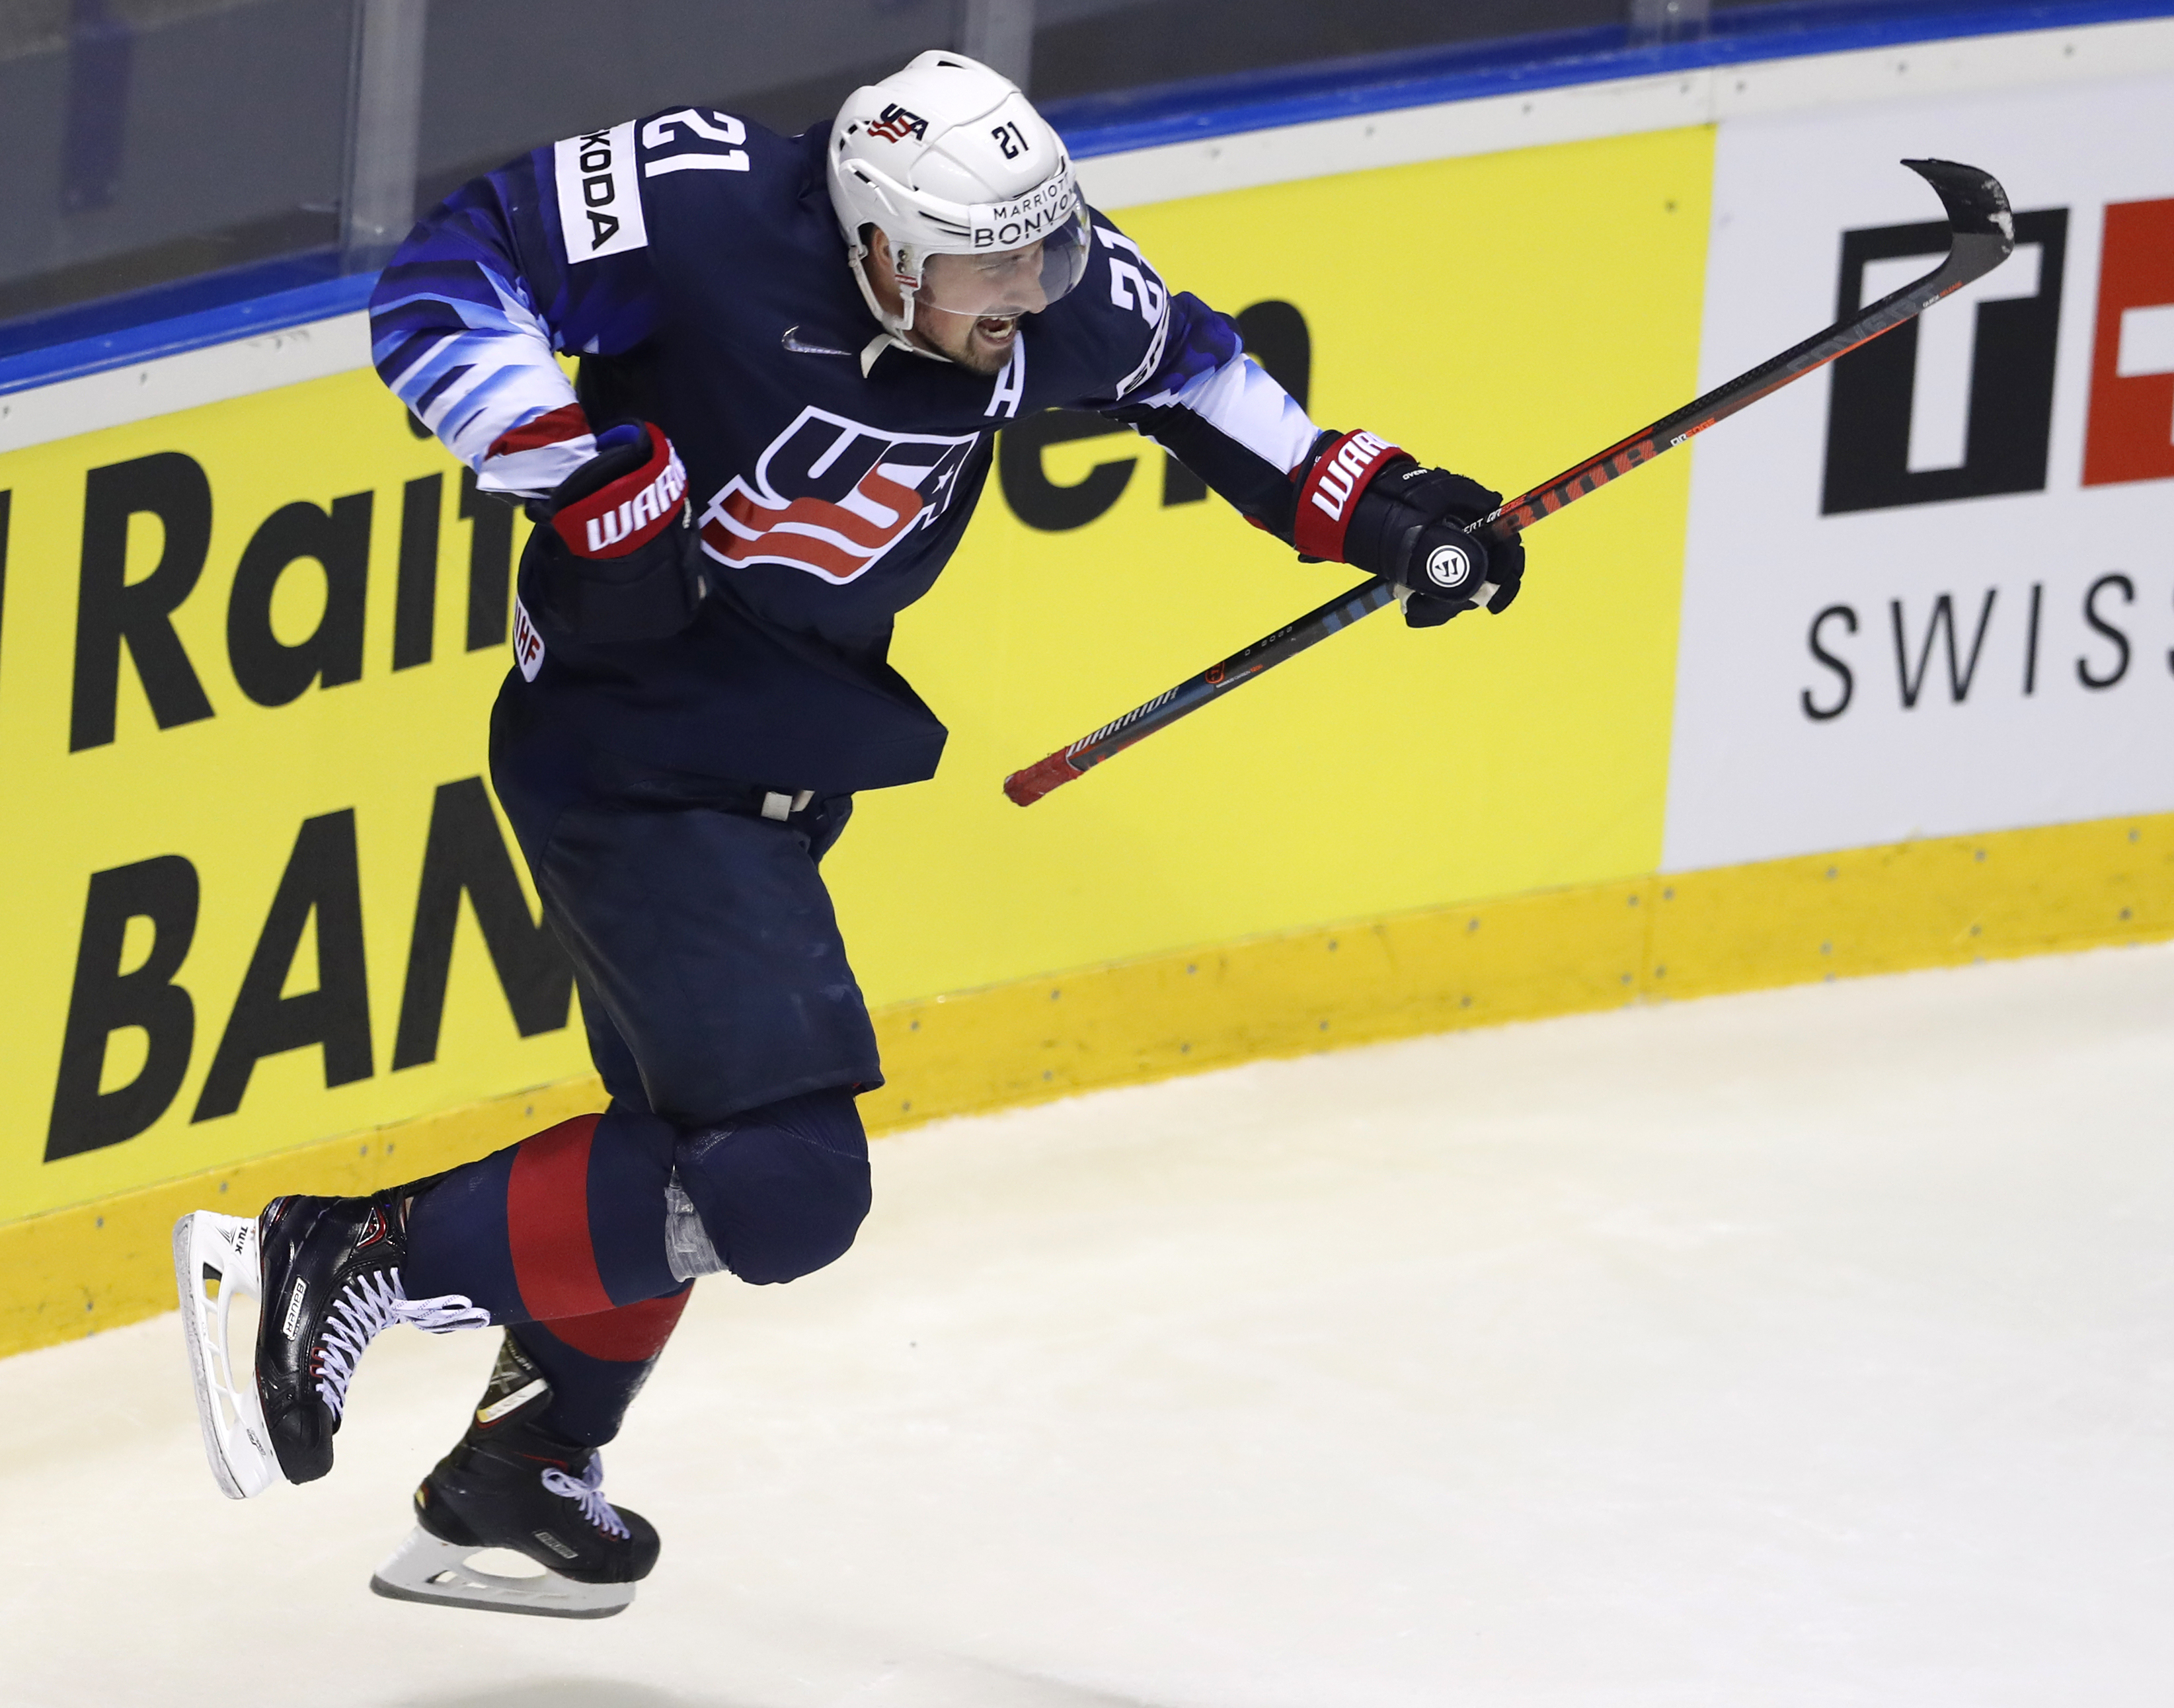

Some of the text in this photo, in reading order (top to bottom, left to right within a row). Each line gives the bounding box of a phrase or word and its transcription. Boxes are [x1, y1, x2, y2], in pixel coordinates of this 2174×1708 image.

[642, 108, 750, 178] 21
[867, 102, 929, 144] USA
[991, 122, 1029, 159] 21
[580, 130, 619, 251] KODA
[984, 330, 1025, 418] A
[1800, 572, 2174, 721] SWIS
[43, 775, 576, 1165] BAN
